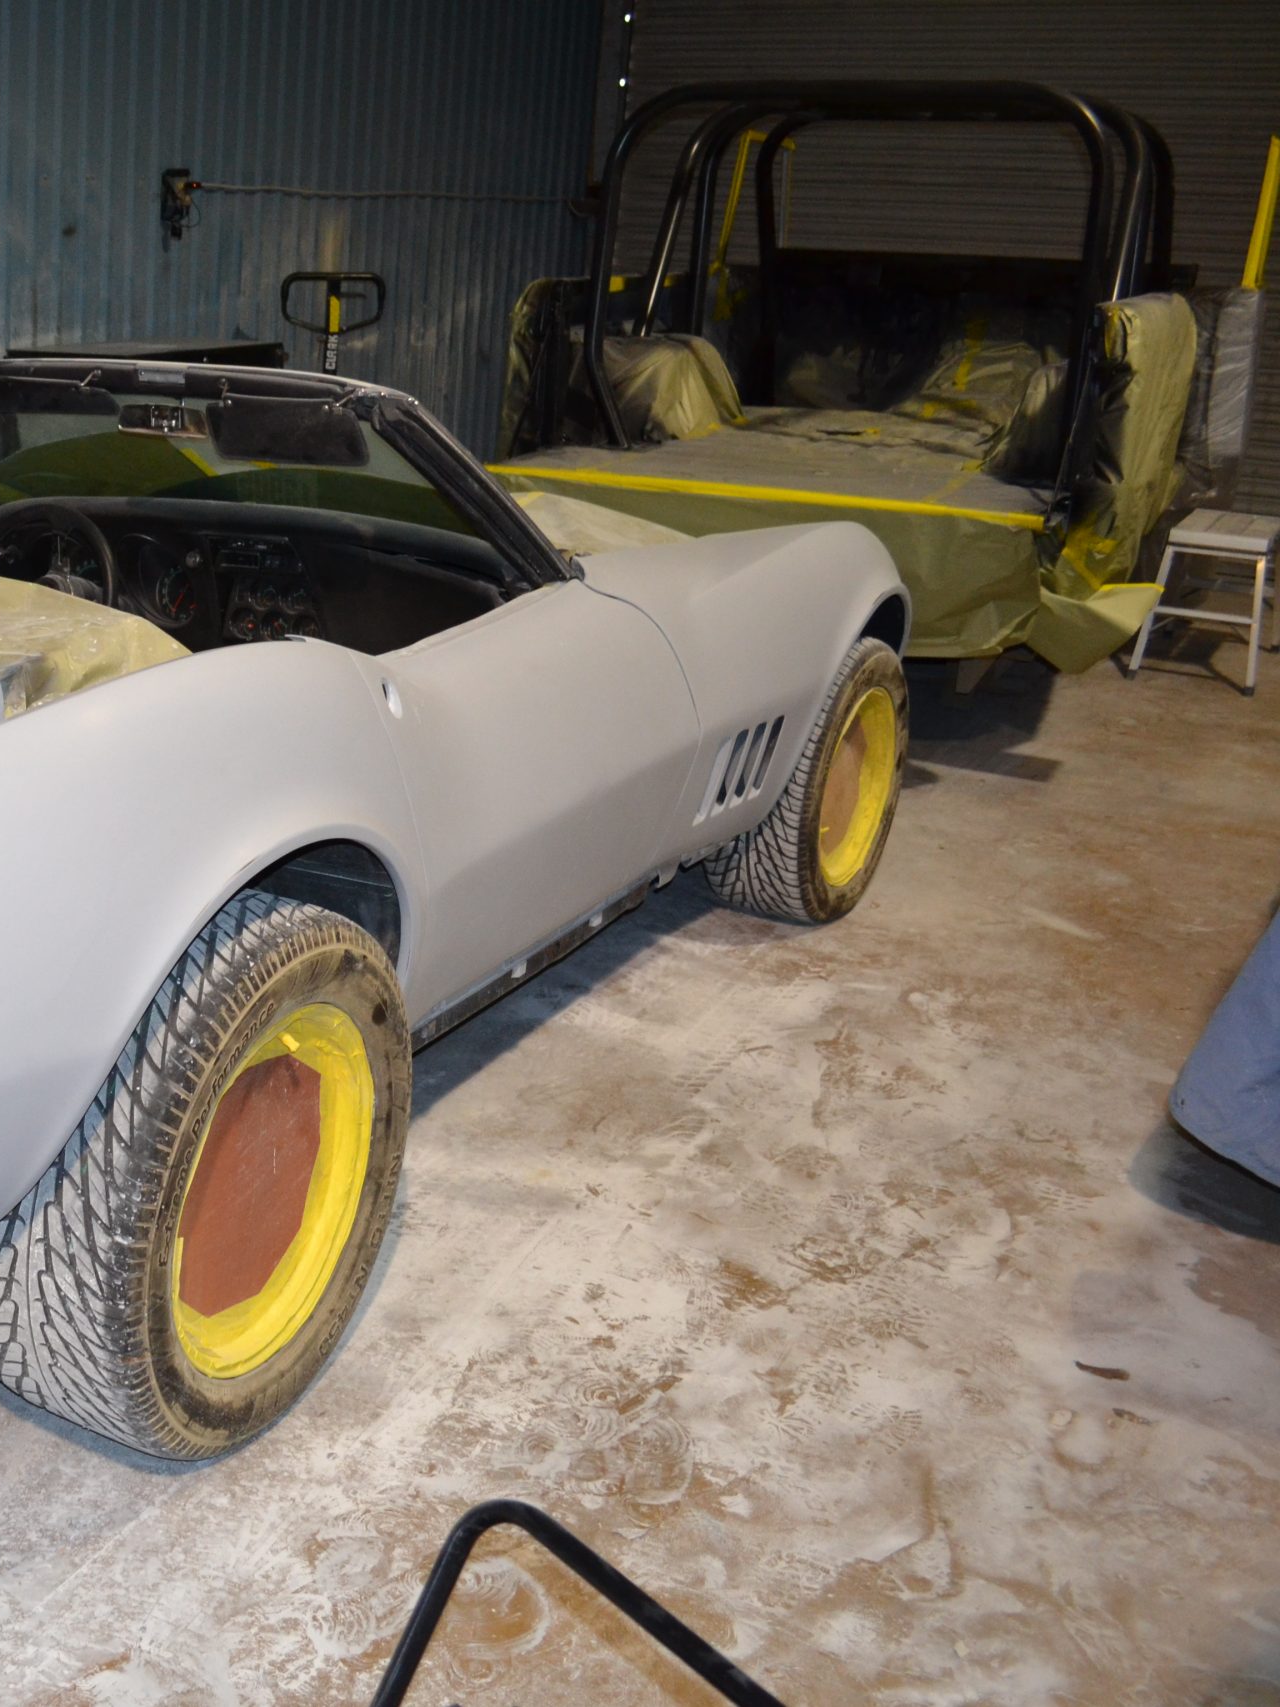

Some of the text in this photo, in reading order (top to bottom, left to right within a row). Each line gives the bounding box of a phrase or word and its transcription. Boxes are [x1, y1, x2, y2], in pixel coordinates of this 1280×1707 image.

[325, 334, 338, 370] CLARK
[191, 1002, 276, 1138] Performance
[319, 1153, 402, 1357] NITTO NT450
